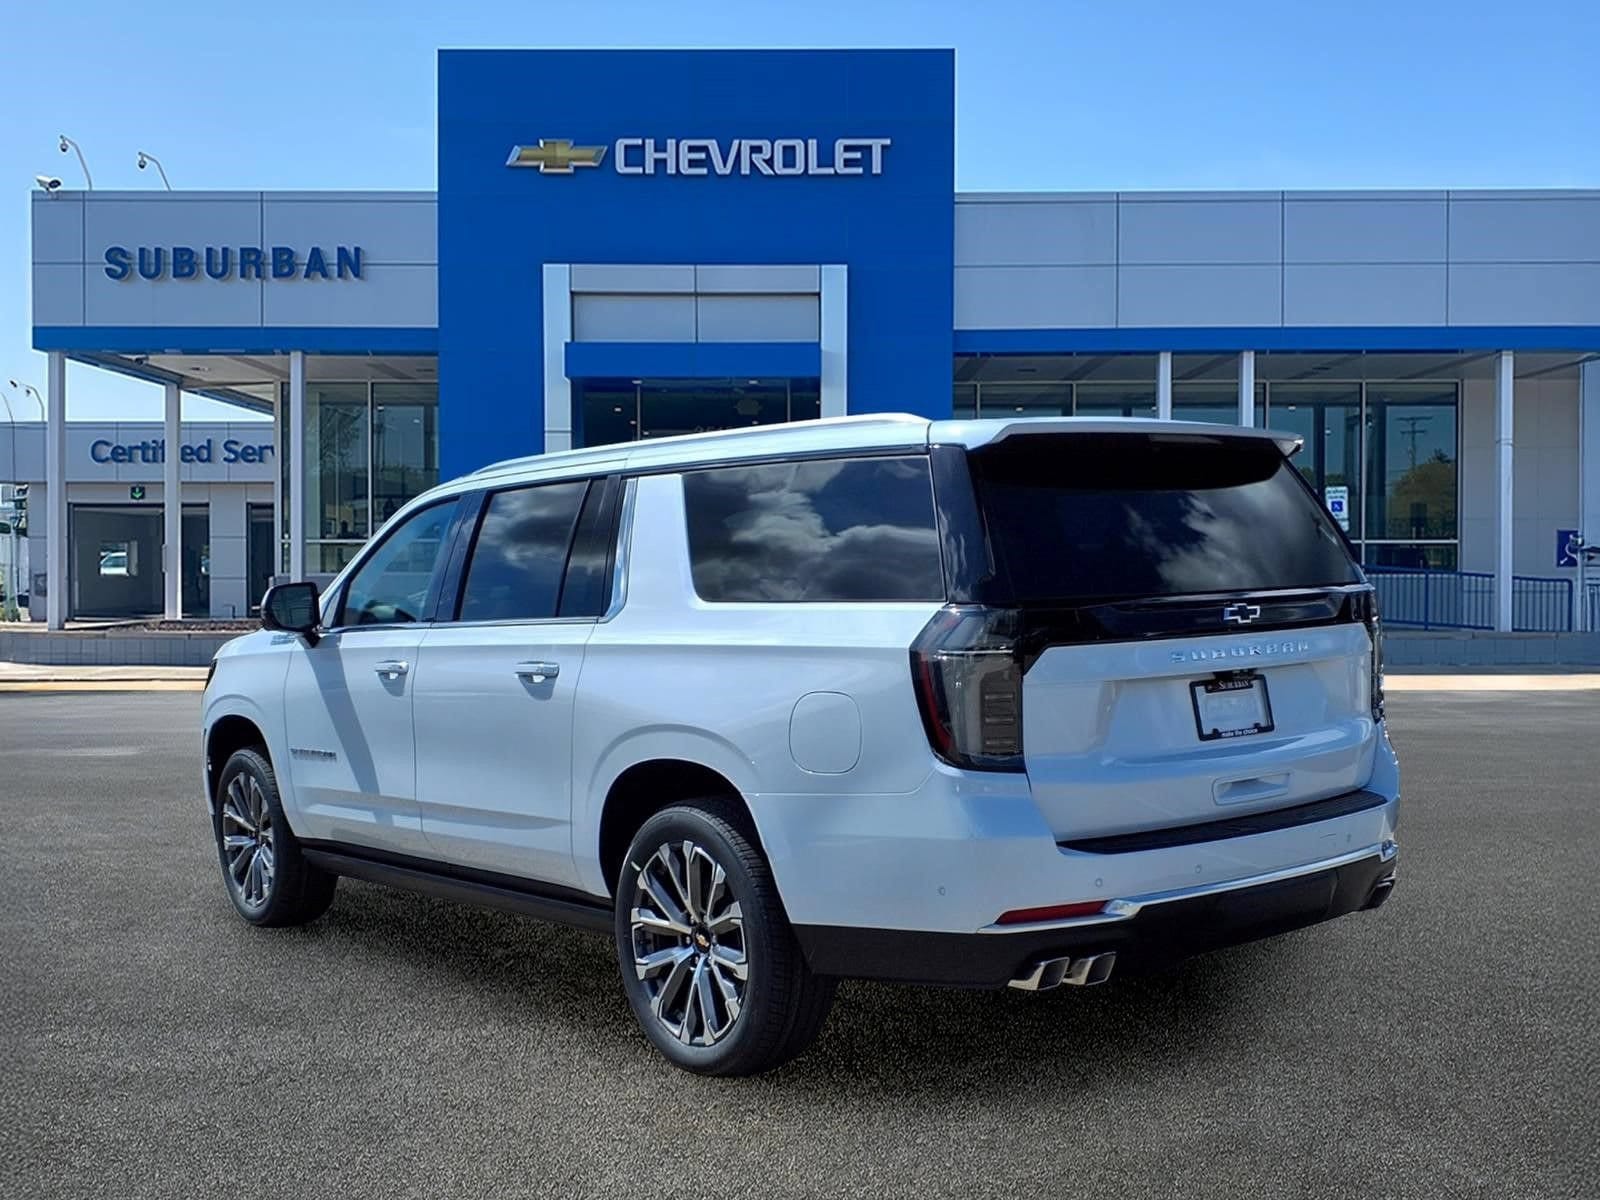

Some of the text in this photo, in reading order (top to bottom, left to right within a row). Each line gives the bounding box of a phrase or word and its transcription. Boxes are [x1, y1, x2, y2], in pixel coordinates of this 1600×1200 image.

[614, 138, 892, 176] CHEVROLET
[104, 246, 363, 280] SUBURBAN
[91, 439, 212, 463] Certifed
[1171, 640, 1309, 663] SUBURBAN
